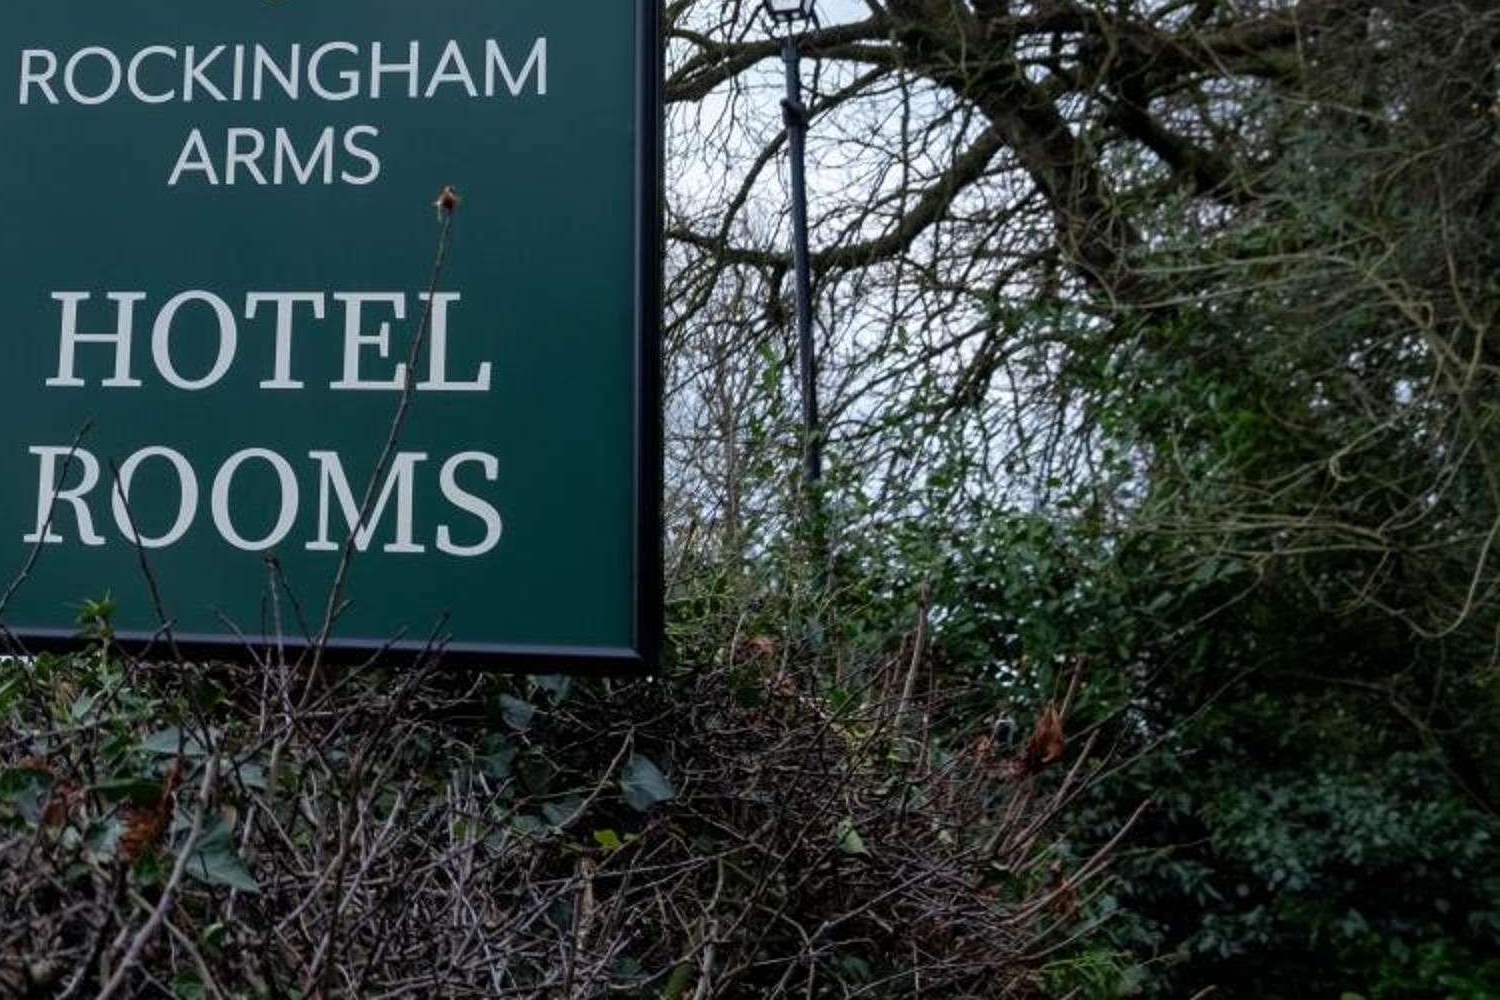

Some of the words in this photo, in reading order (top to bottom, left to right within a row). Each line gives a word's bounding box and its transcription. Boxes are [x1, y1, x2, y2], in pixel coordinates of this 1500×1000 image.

[19, 37, 548, 105] ROCKINGHAM
[167, 125, 381, 186] ARMS
[45, 289, 492, 392] HOTEL
[23, 445, 503, 556] ROOMS
